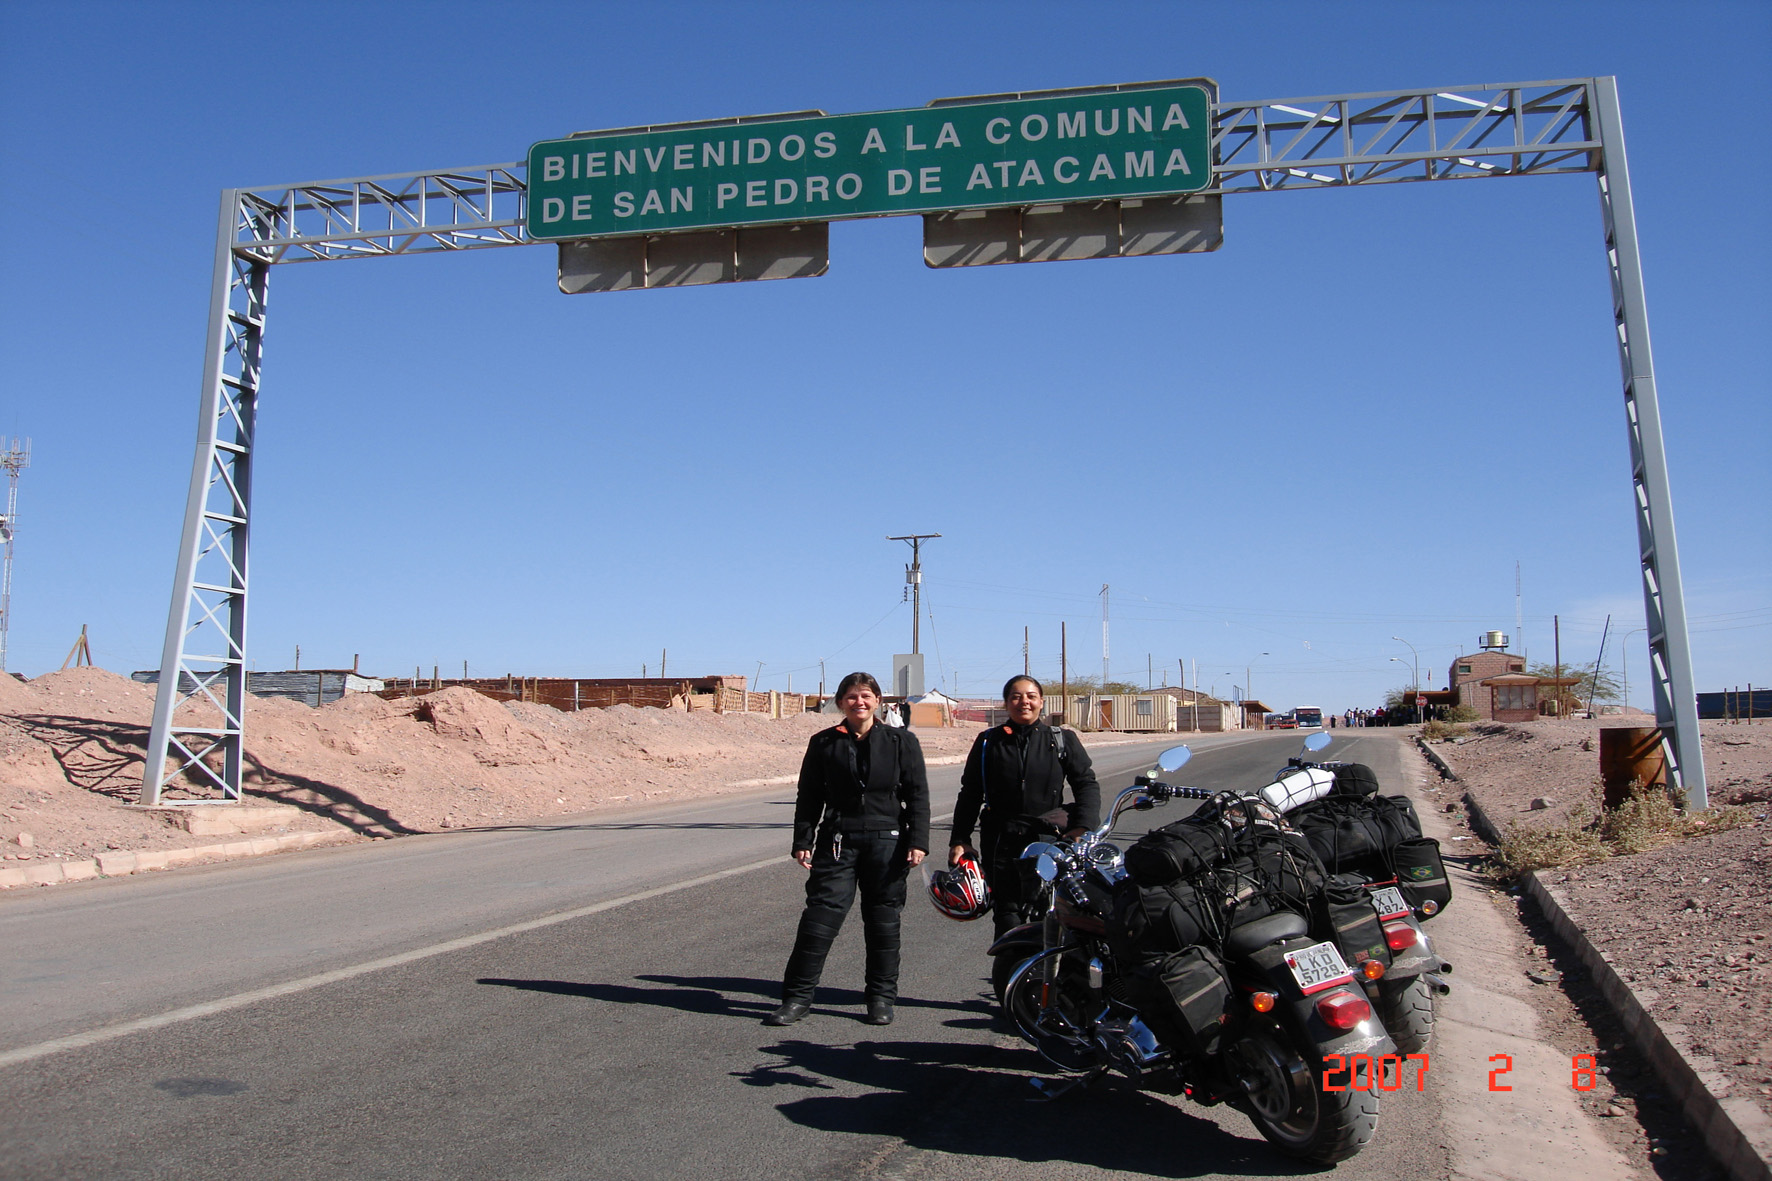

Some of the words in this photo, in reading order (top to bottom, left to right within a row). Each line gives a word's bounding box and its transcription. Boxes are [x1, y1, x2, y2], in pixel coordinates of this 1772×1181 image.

[543, 131, 837, 182] BIENVENIDOS
[860, 127, 887, 155] A
[905, 121, 962, 151] LA
[985, 103, 1190, 145] COMUNA
[543, 194, 593, 224] DE
[612, 186, 694, 218] SAN
[717, 172, 863, 210] PEDRO
[887, 166, 942, 196] DE
[965, 148, 1192, 193] ATACAMA
[1302, 964, 1340, 983] 5729
